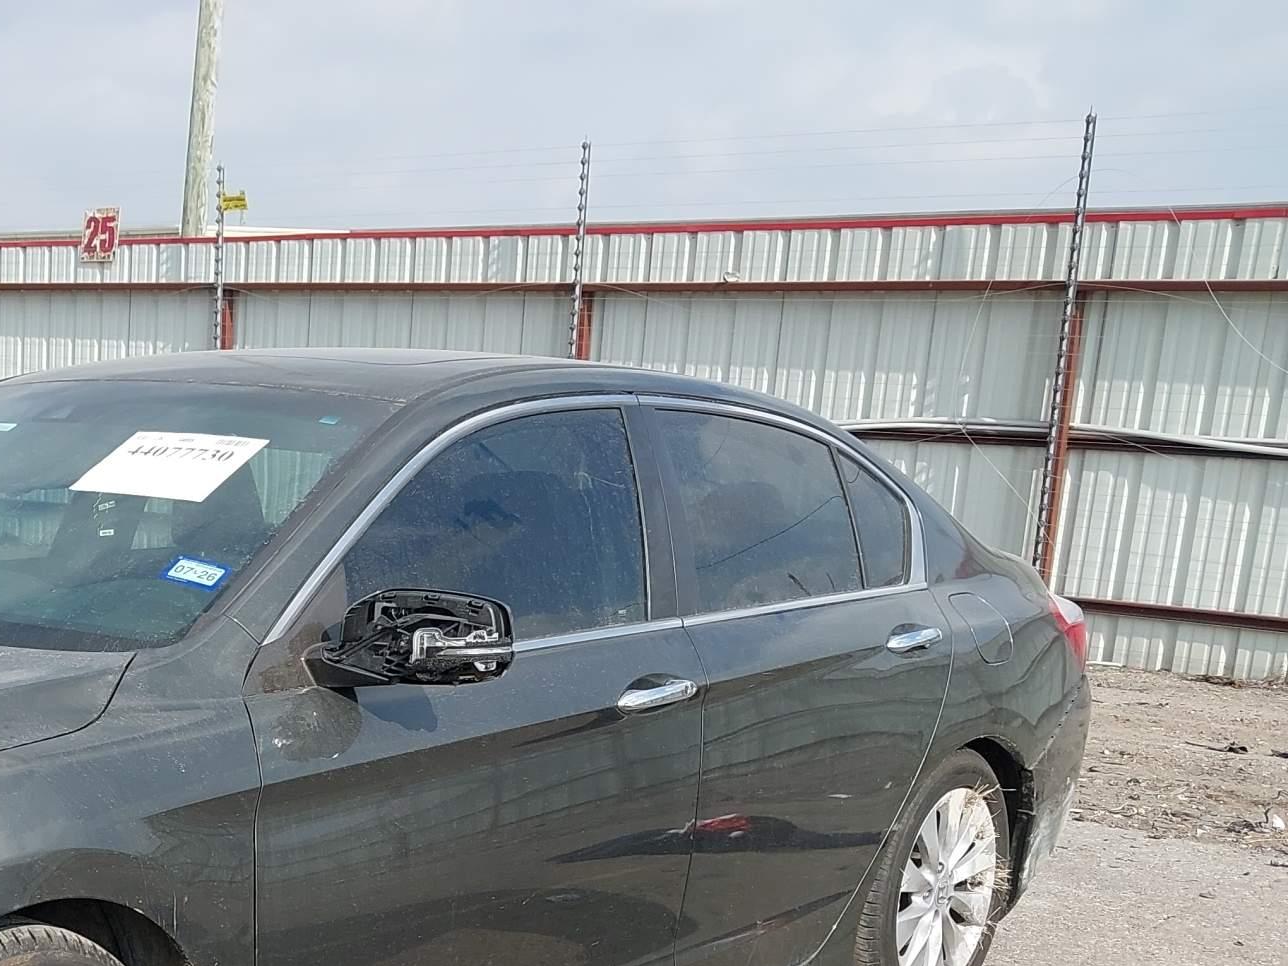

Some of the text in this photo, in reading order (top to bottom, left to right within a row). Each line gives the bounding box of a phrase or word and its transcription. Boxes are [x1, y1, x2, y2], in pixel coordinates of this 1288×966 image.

[84, 216, 116, 253] 25
[128, 445, 234, 462] 44077730
[174, 564, 194, 576] 07
[197, 570, 218, 582] 26
